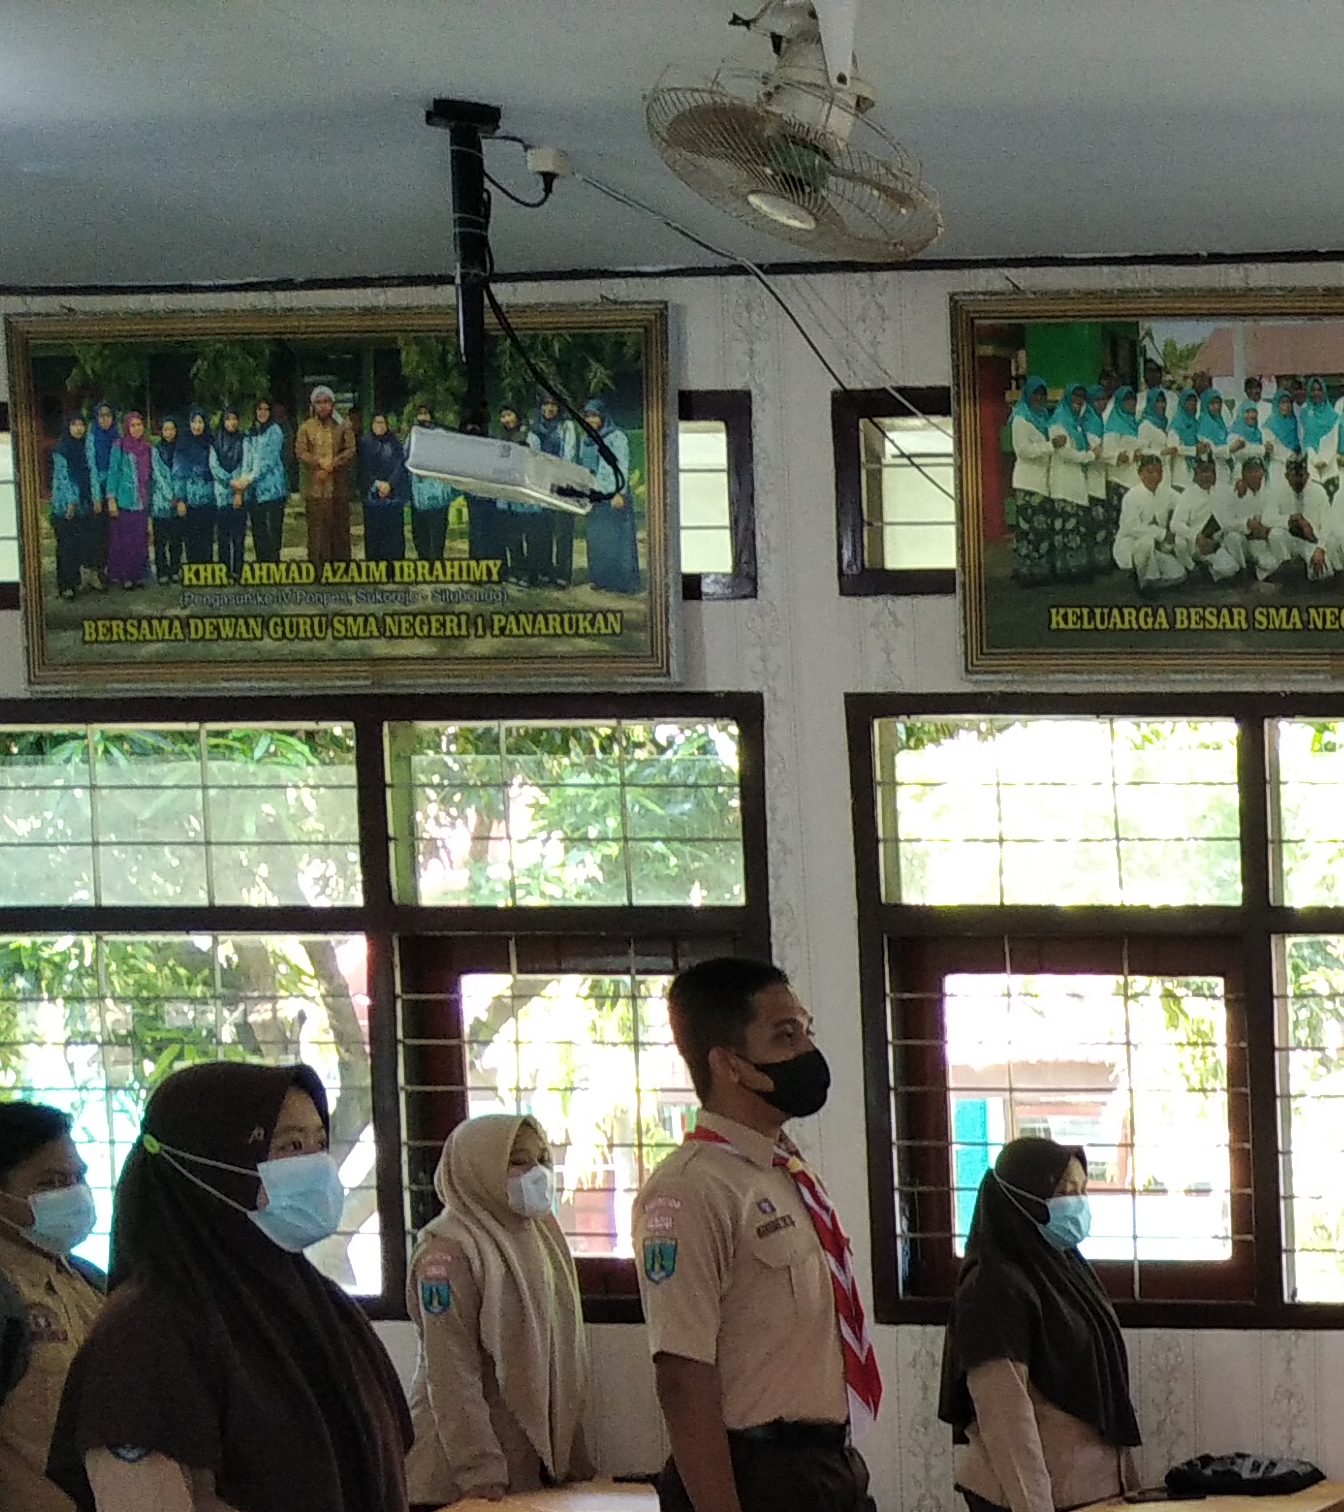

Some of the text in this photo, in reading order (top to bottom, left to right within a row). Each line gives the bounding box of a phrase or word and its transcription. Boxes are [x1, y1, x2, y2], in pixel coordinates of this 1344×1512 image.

[182, 557, 503, 587] KHR. AHMAD AZAIM IBRAHIMY
[83, 611, 623, 643] BERSAMA DEWAN GURU SMA NEGERI 1 PANARUKAN
[1049, 606, 1171, 631] KELUARGA
[1173, 606, 1249, 631] BESAR
[1253, 606, 1303, 631] SMA
